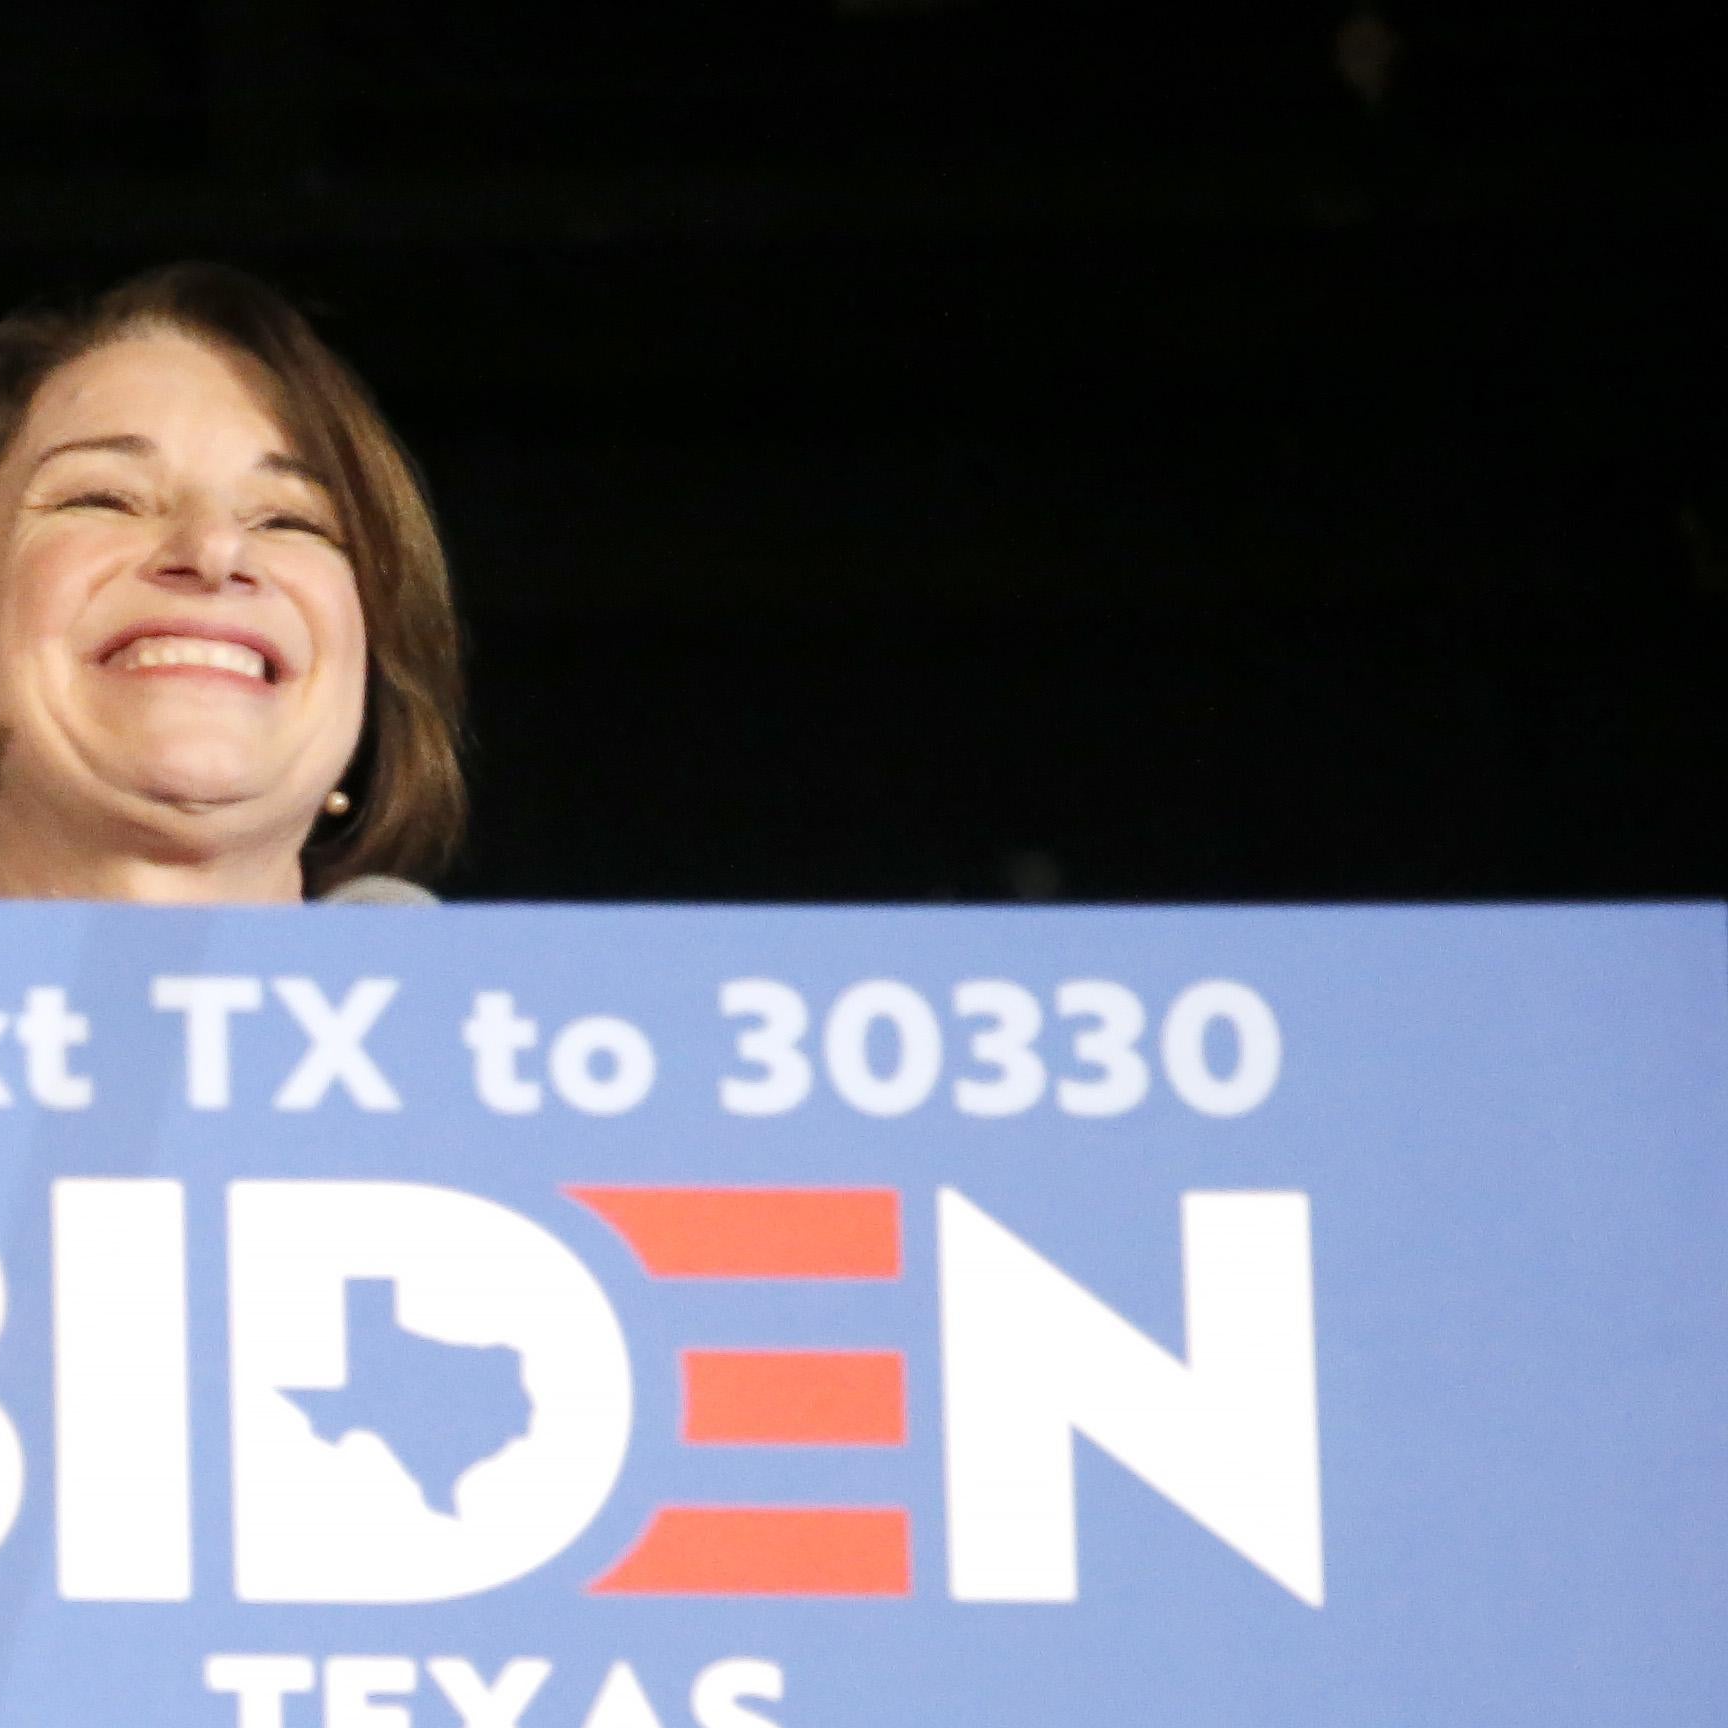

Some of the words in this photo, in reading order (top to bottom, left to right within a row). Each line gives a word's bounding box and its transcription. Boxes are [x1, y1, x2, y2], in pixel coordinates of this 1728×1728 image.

[150, 975, 404, 1112] TX
[462, 991, 656, 1117] to
[718, 978, 1283, 1120] 30330
